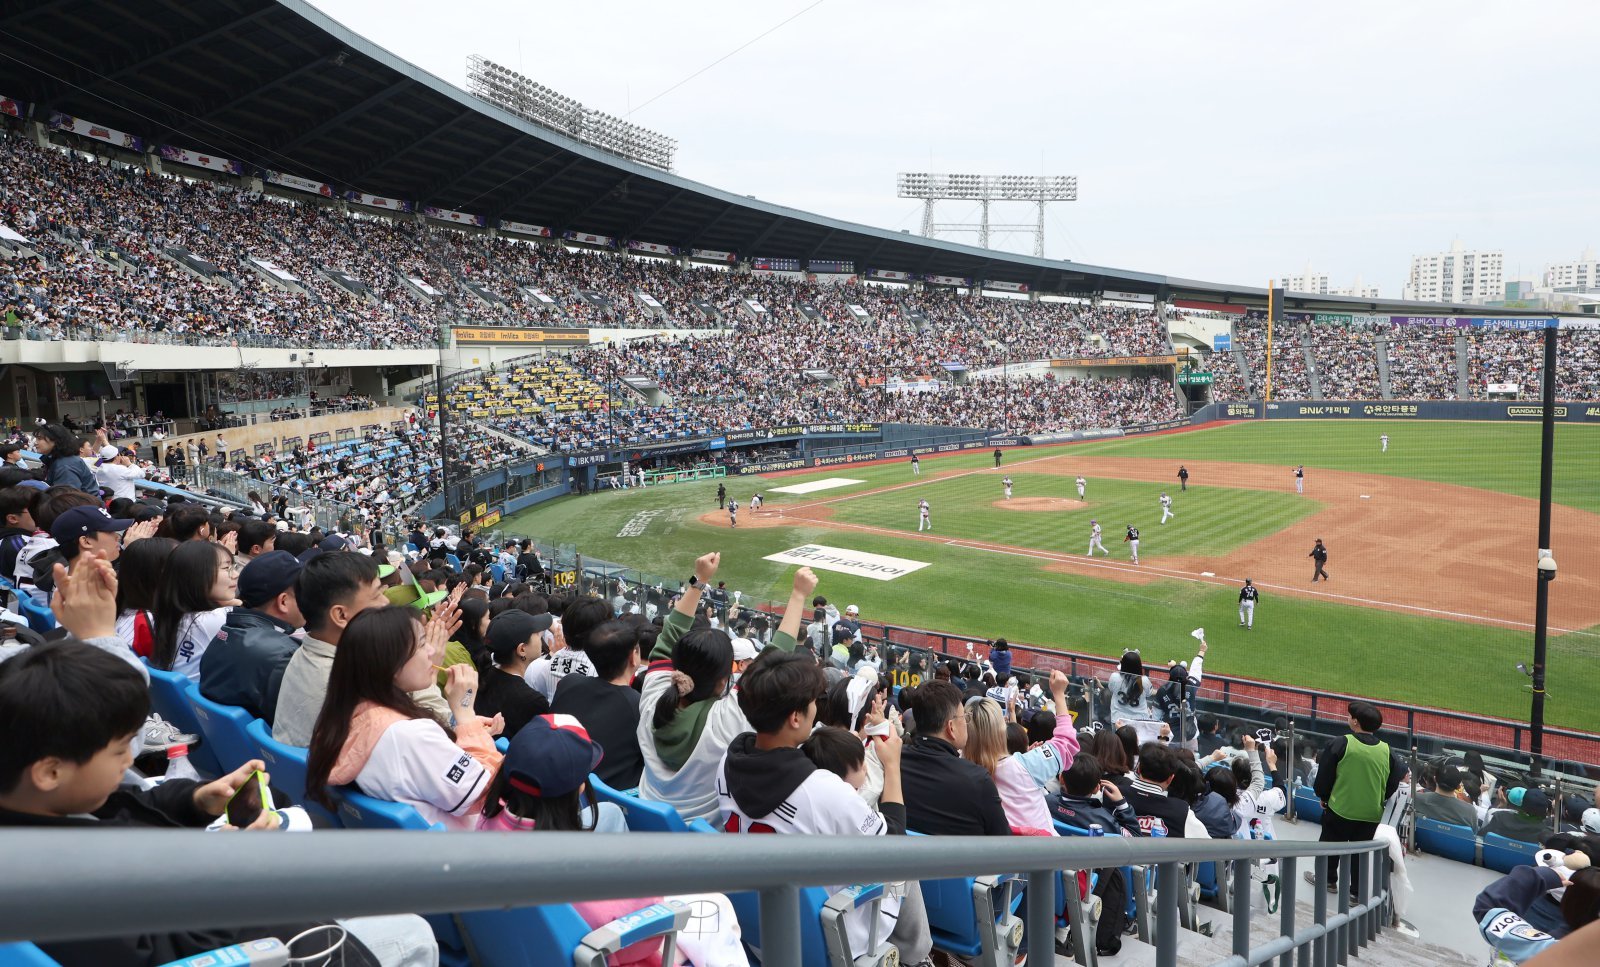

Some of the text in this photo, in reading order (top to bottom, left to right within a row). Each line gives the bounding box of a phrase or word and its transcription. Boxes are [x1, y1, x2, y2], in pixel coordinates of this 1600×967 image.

[1299, 406, 1350, 414] BNK 캐피탈
[1374, 405, 1418, 413] 유안타증권
[578, 456, 590, 465] IBK
[554, 571, 576, 586] 109
